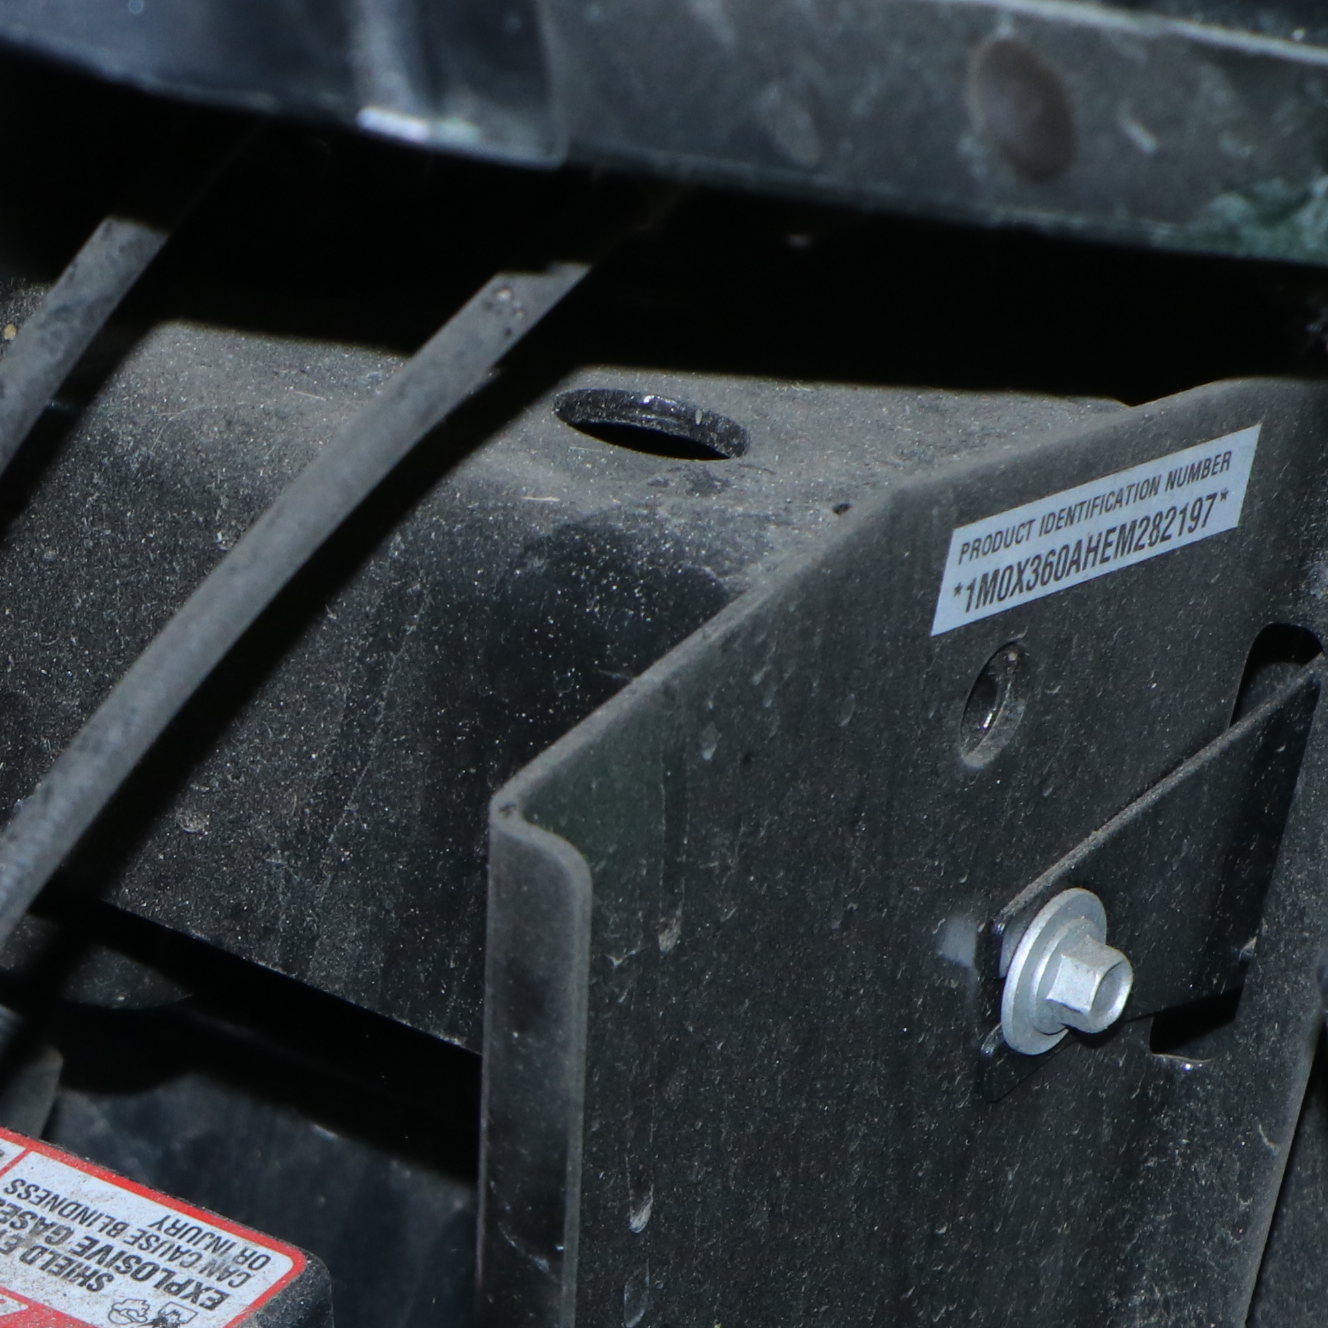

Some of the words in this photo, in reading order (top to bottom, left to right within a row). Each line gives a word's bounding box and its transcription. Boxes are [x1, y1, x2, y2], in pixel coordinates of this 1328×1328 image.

[956, 517, 1036, 566] PRODUCT
[1037, 473, 1162, 537] IDENTIFICATION
[1163, 448, 1234, 493] NUMBER
[0, 1176, 131, 1238] BLINDNESS
[121, 1227, 205, 1270] CAUSE
[146, 1211, 238, 1257] INJURY
[14, 1242, 117, 1295] SHIELD
[66, 1234, 231, 1312] EXPLOSIVE
[198, 1259, 253, 1290] CAN
[227, 1245, 274, 1273] OR
